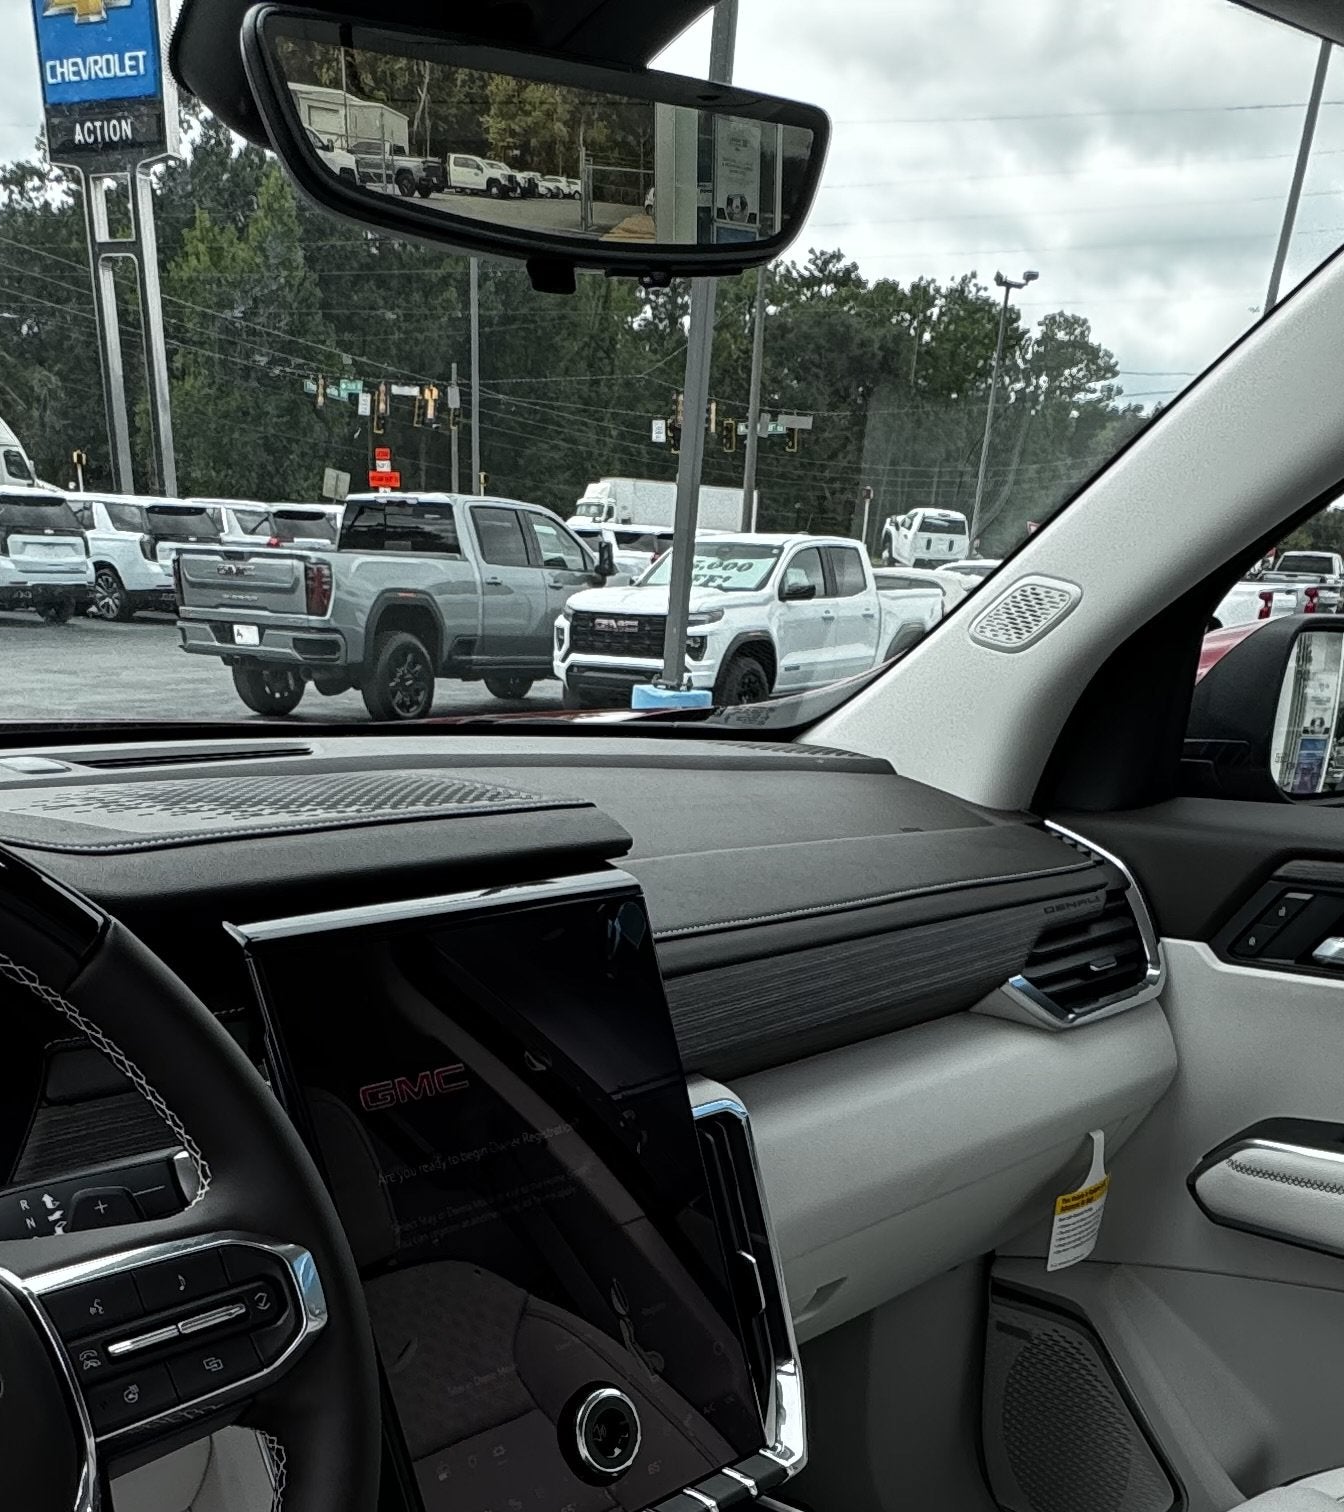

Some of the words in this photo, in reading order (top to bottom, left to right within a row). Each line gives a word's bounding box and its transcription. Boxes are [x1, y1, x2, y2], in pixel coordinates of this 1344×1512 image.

[46, 51, 146, 84] CHEVROLET
[74, 119, 132, 145] ACTION
[359, 1063, 471, 1112] GMC
[19, 1199, 31, 1212] R
[25, 1216, 37, 1230] N
